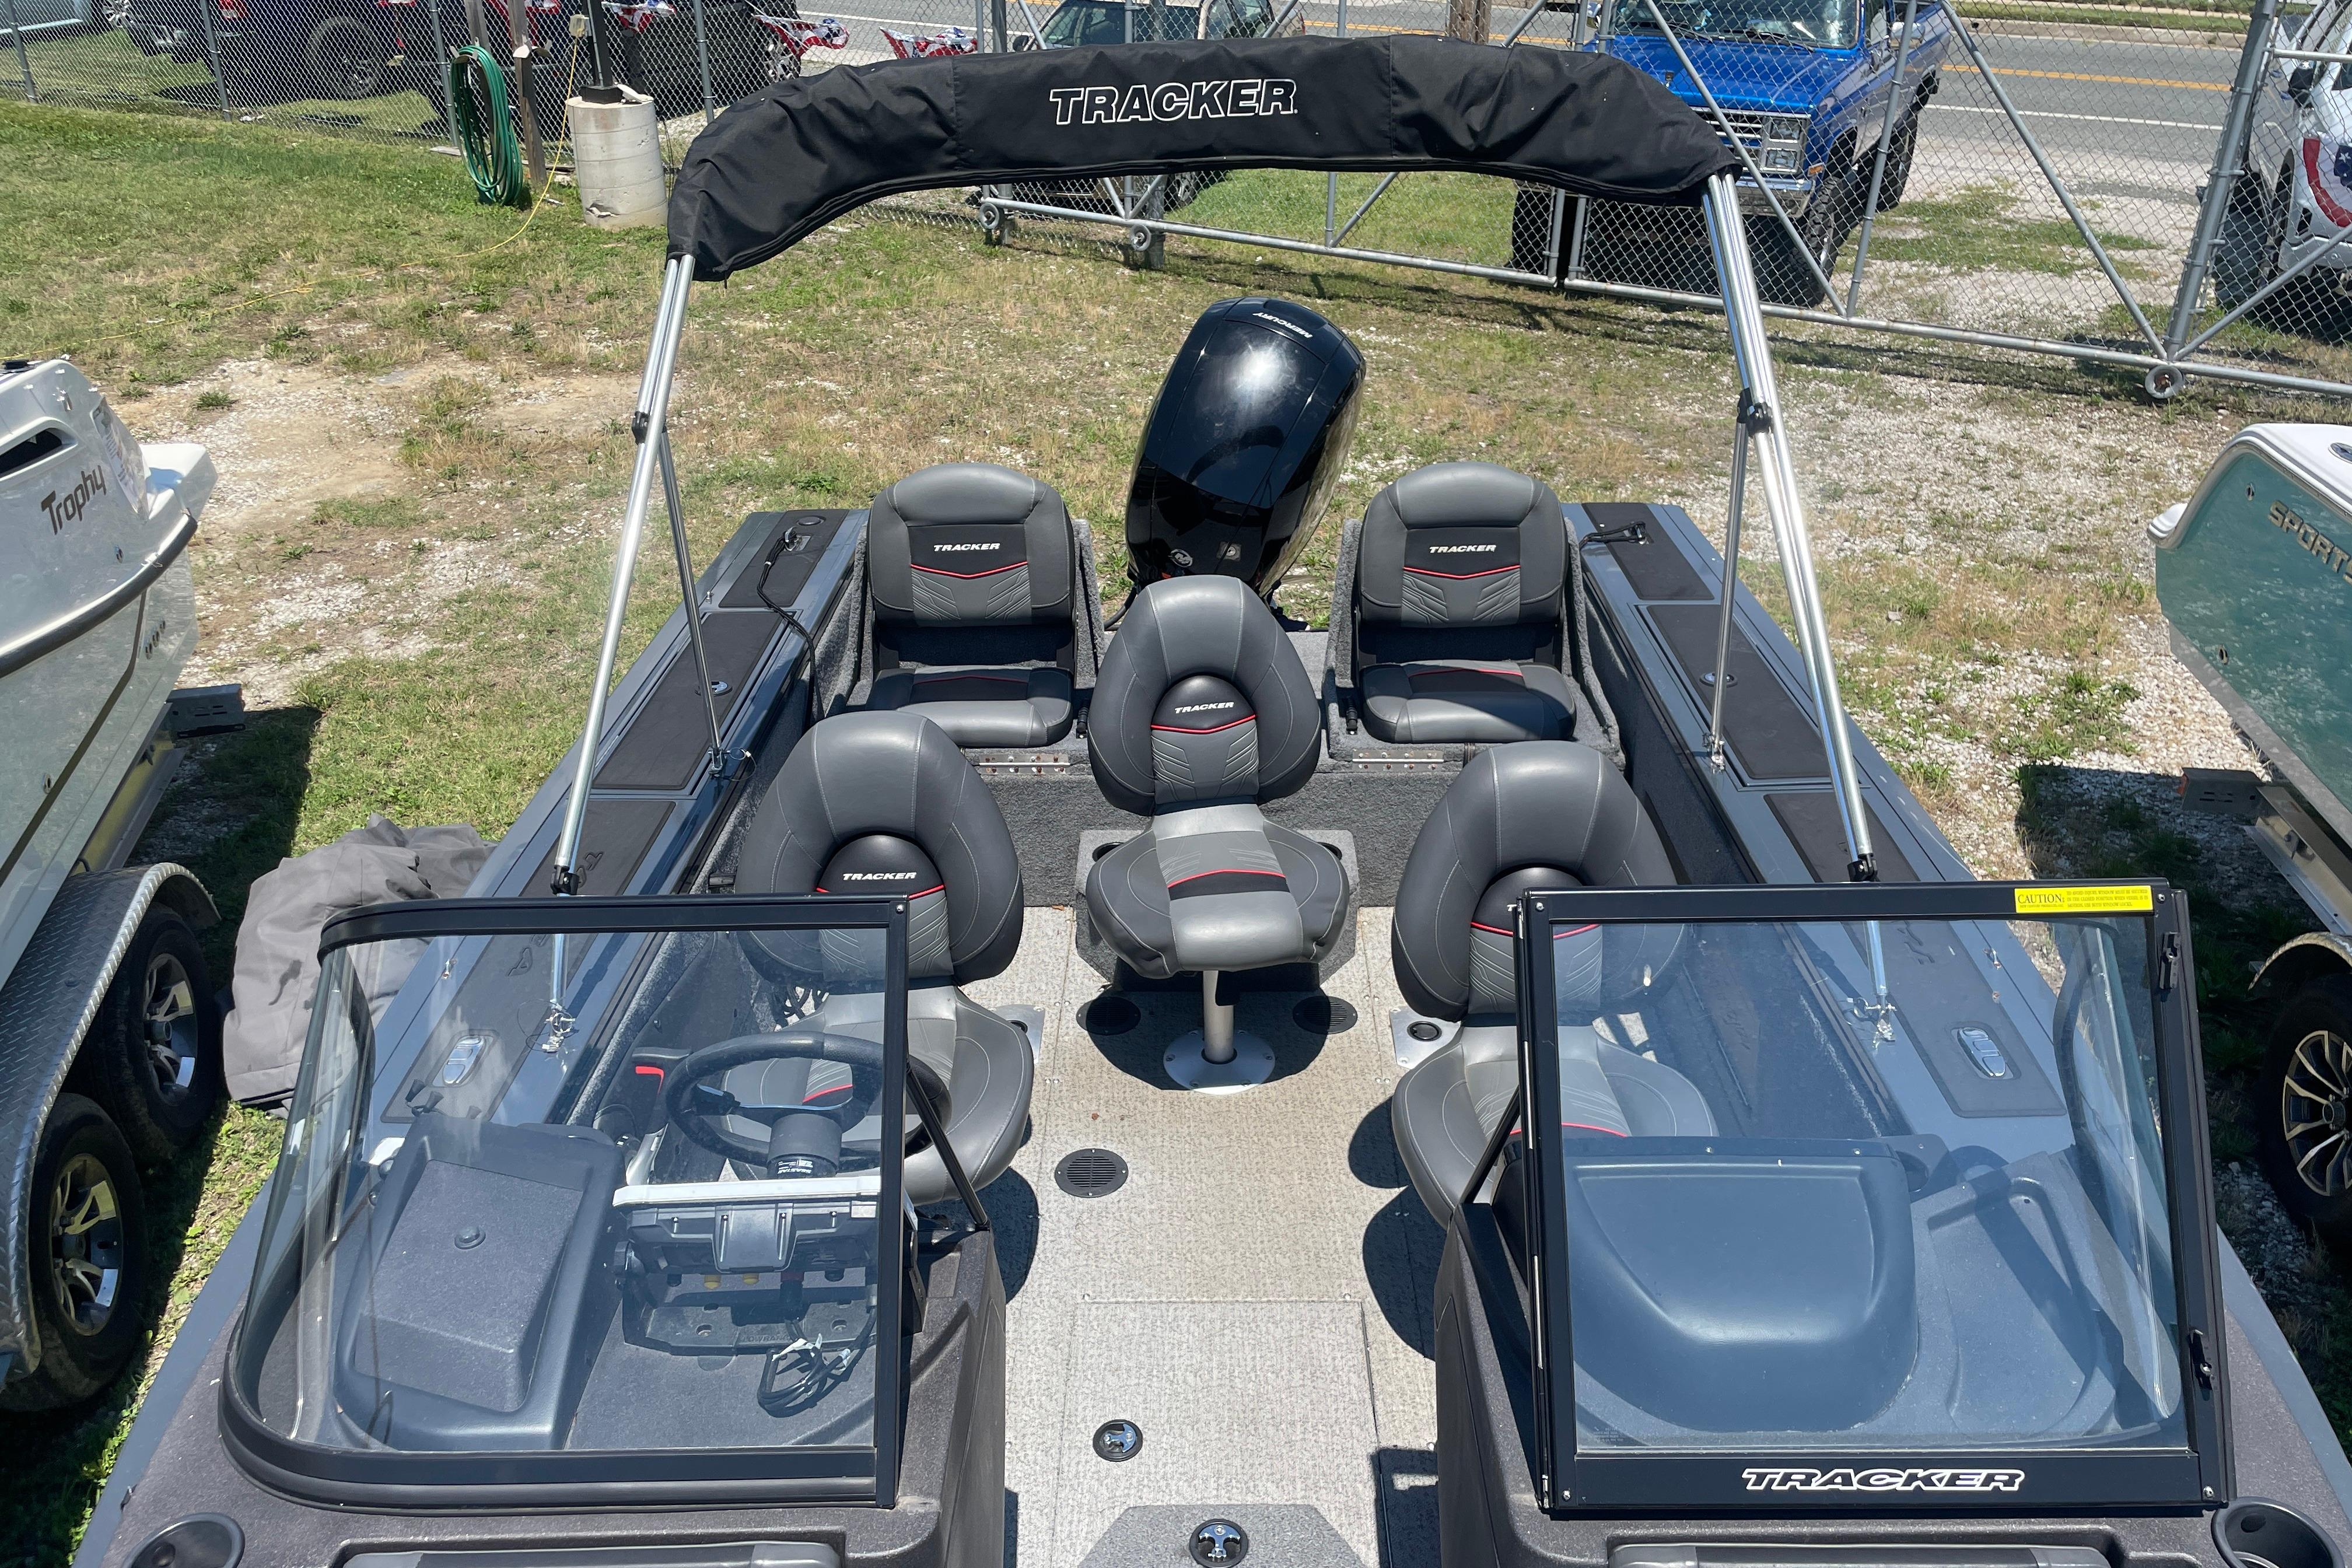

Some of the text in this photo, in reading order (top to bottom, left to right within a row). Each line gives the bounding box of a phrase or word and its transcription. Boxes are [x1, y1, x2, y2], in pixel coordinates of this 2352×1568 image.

[1049, 78, 1297, 125] TRACKER
[1252, 312, 1313, 338] MERCURY
[41, 465, 107, 536] Trophy
[933, 542, 1000, 552] TRACKER
[1429, 544, 1497, 553] TRACKER
[1174, 702, 1234, 714] TRACKER
[843, 872, 917, 880] TRACKER
[1742, 1469, 2025, 1491] TRACKER
